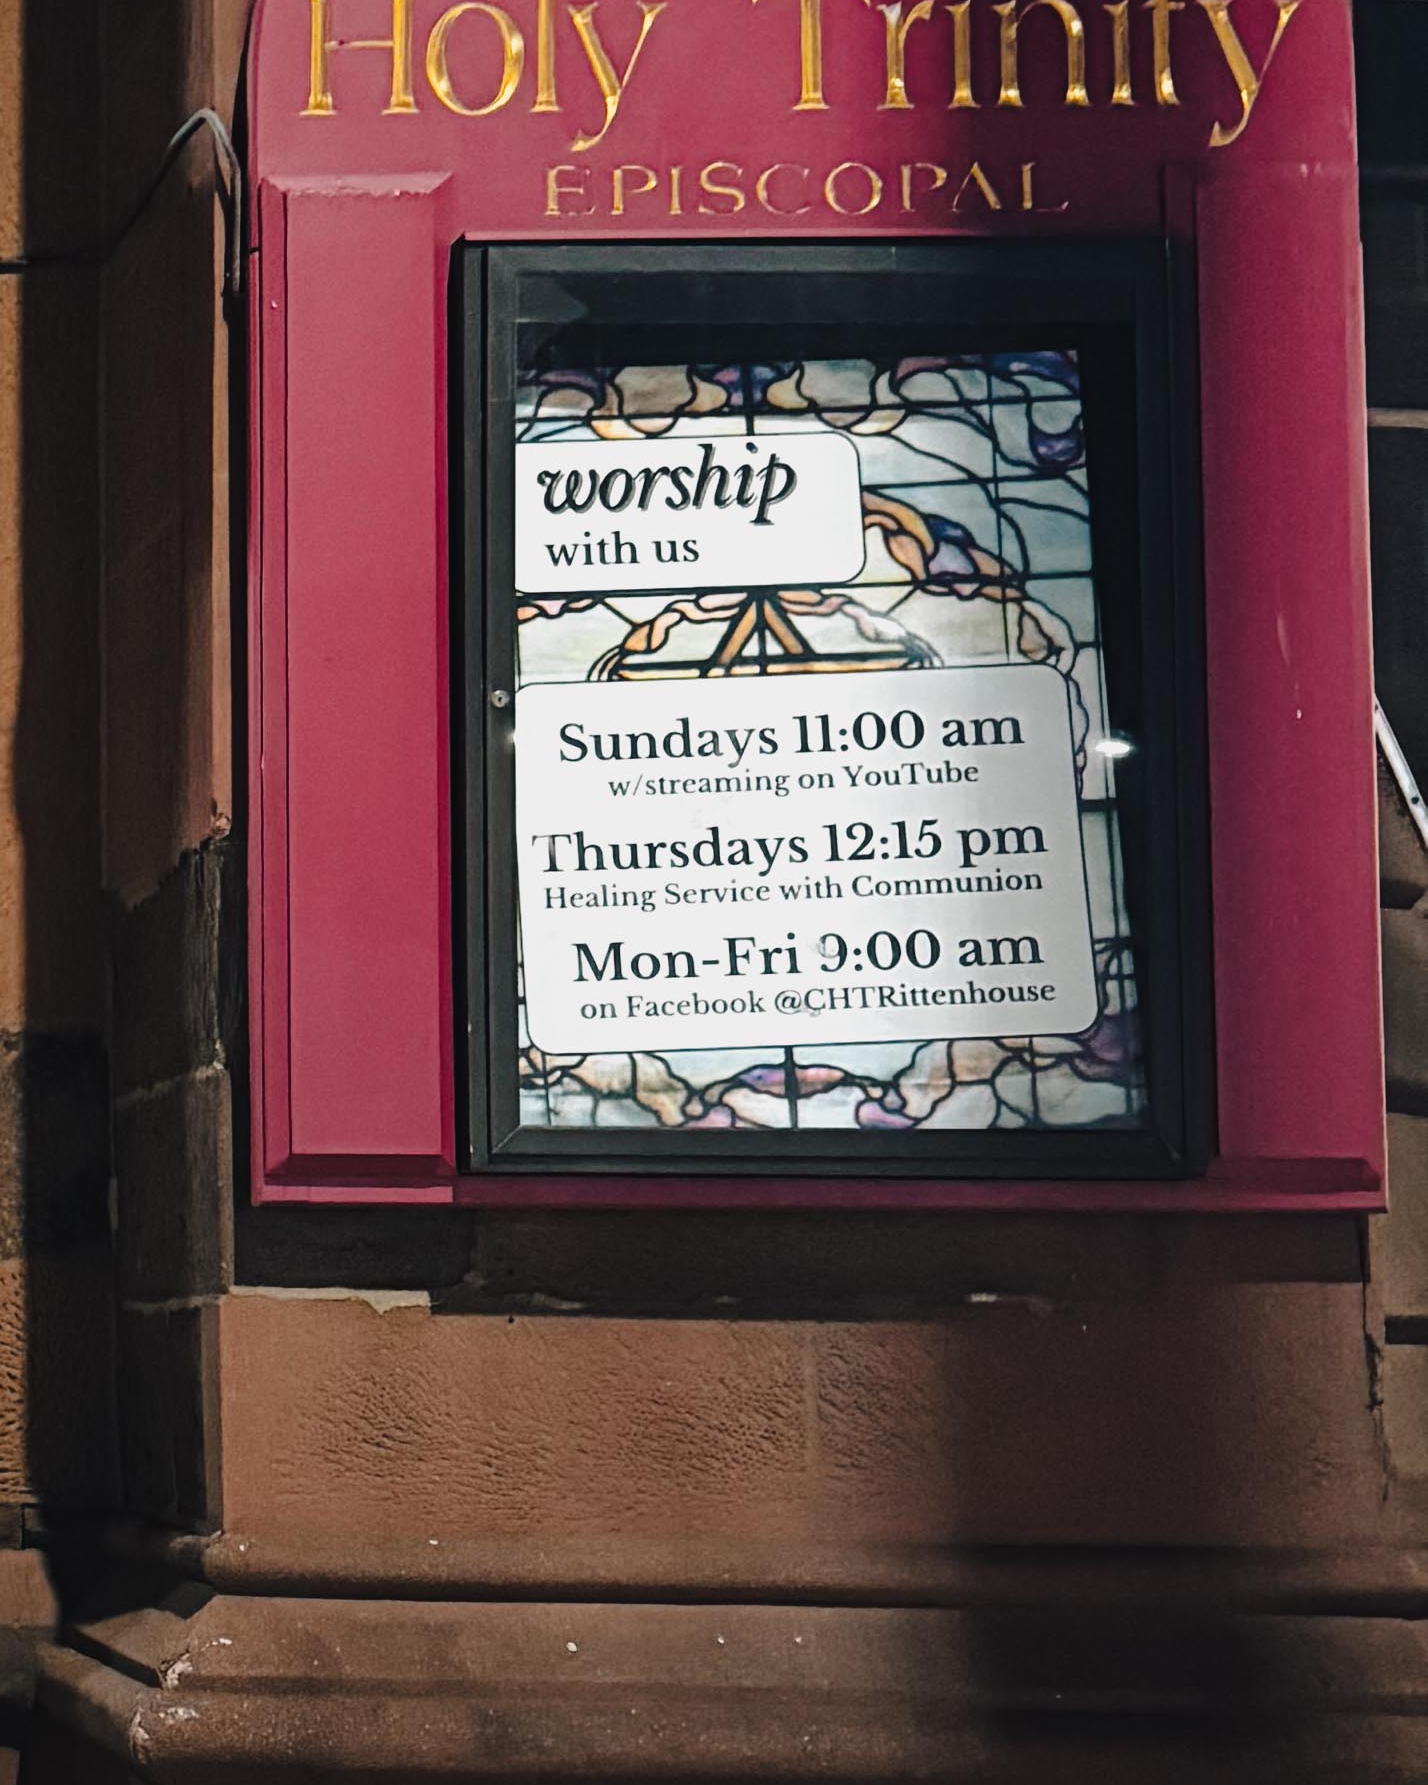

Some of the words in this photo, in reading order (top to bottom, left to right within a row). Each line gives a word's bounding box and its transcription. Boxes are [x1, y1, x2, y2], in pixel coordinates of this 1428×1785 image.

[544, 161, 1070, 217] EPISCOPAL
[537, 442, 796, 525] worship
[546, 531, 639, 566] with
[653, 540, 699, 562] us
[560, 718, 778, 768] Sundays
[793, 710, 924, 753] 11:00
[943, 717, 1025, 747] am
[607, 768, 791, 799] w/streaming
[799, 774, 834, 788] on
[844, 761, 978, 786] YouTube
[532, 827, 808, 876] Thursdays
[823, 819, 941, 861] 12:15
[957, 826, 1048, 868] pm
[546, 885, 655, 911] Healing
[664, 879, 771, 906] Service
[780, 876, 842, 899] with
[852, 868, 1043, 896] Communion
[573, 933, 800, 981] Mon-Fri
[821, 930, 940, 972] 9:00
[959, 936, 1045, 967] am
[581, 1004, 616, 1018] on
[628, 991, 764, 1017] Facebook
[775, 981, 1056, 1012] @CHTRittenhouse
